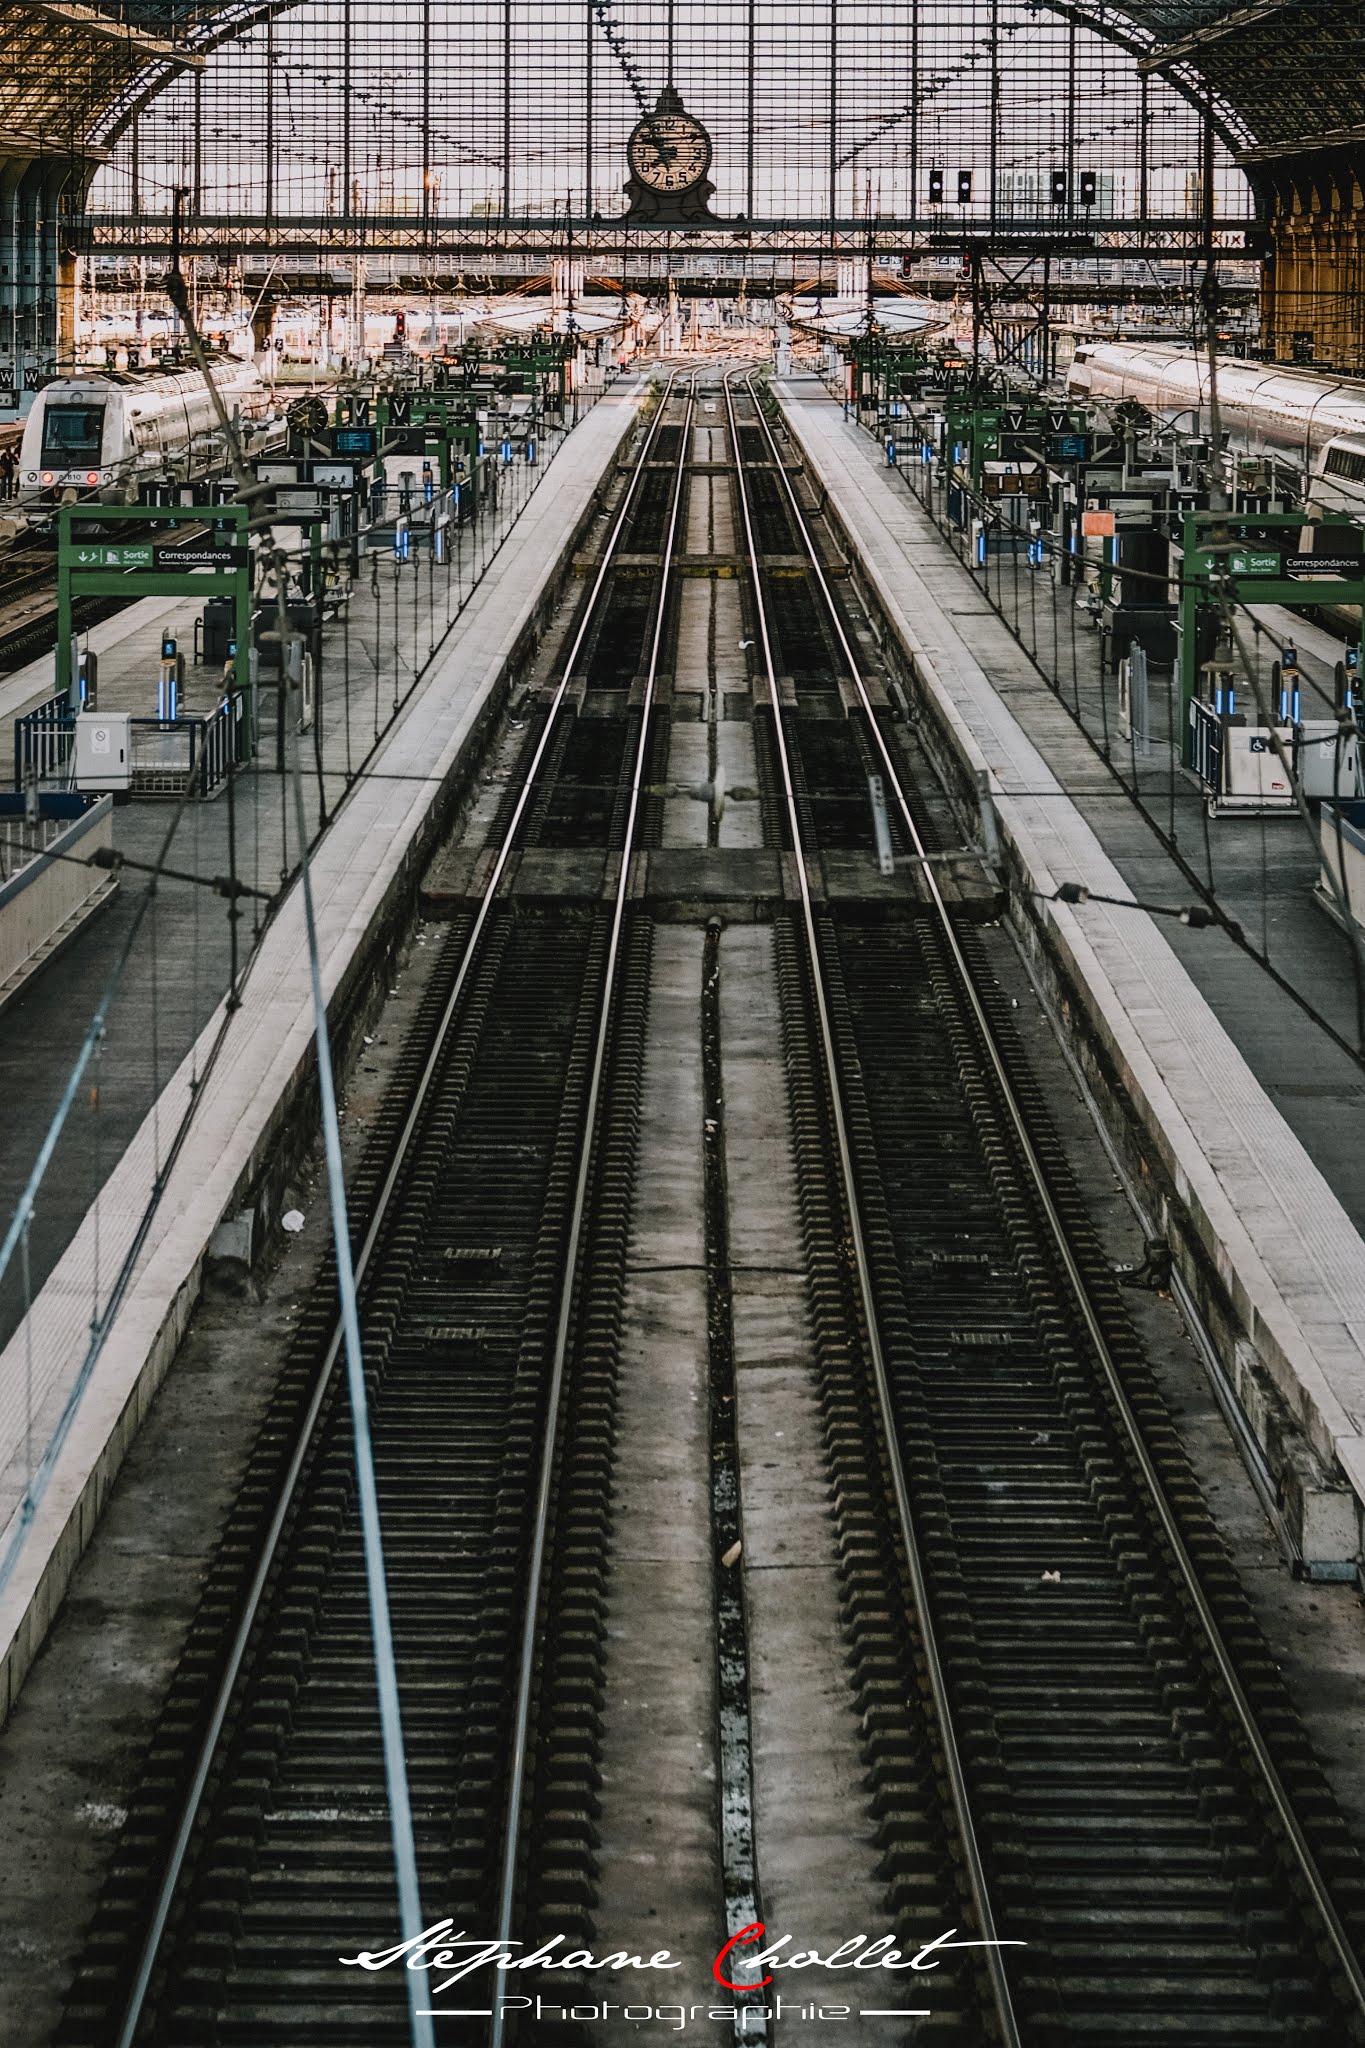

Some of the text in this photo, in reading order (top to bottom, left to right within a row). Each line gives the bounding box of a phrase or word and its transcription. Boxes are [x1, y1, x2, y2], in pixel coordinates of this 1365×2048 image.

[642, 162, 650, 172] 8
[688, 162, 697, 173] 4
[652, 172, 661, 184] 7
[665, 175, 674, 186] 6
[678, 172, 687, 183] 5
[523, 350, 530, 359] X
[464, 362, 479, 374] W
[0, 371, 13, 382] W
[25, 372, 38, 383] W
[934, 370, 948, 381] W
[965, 370, 974, 381] V
[393, 401, 406, 417] V
[1010, 415, 1022, 430] V
[1051, 415, 1063, 430] V
[123, 550, 149, 559] Sortie
[159, 551, 231, 561] Correspondances
[1250, 558, 1277, 567] Sortie
[1286, 558, 1359, 567] Correspondances
